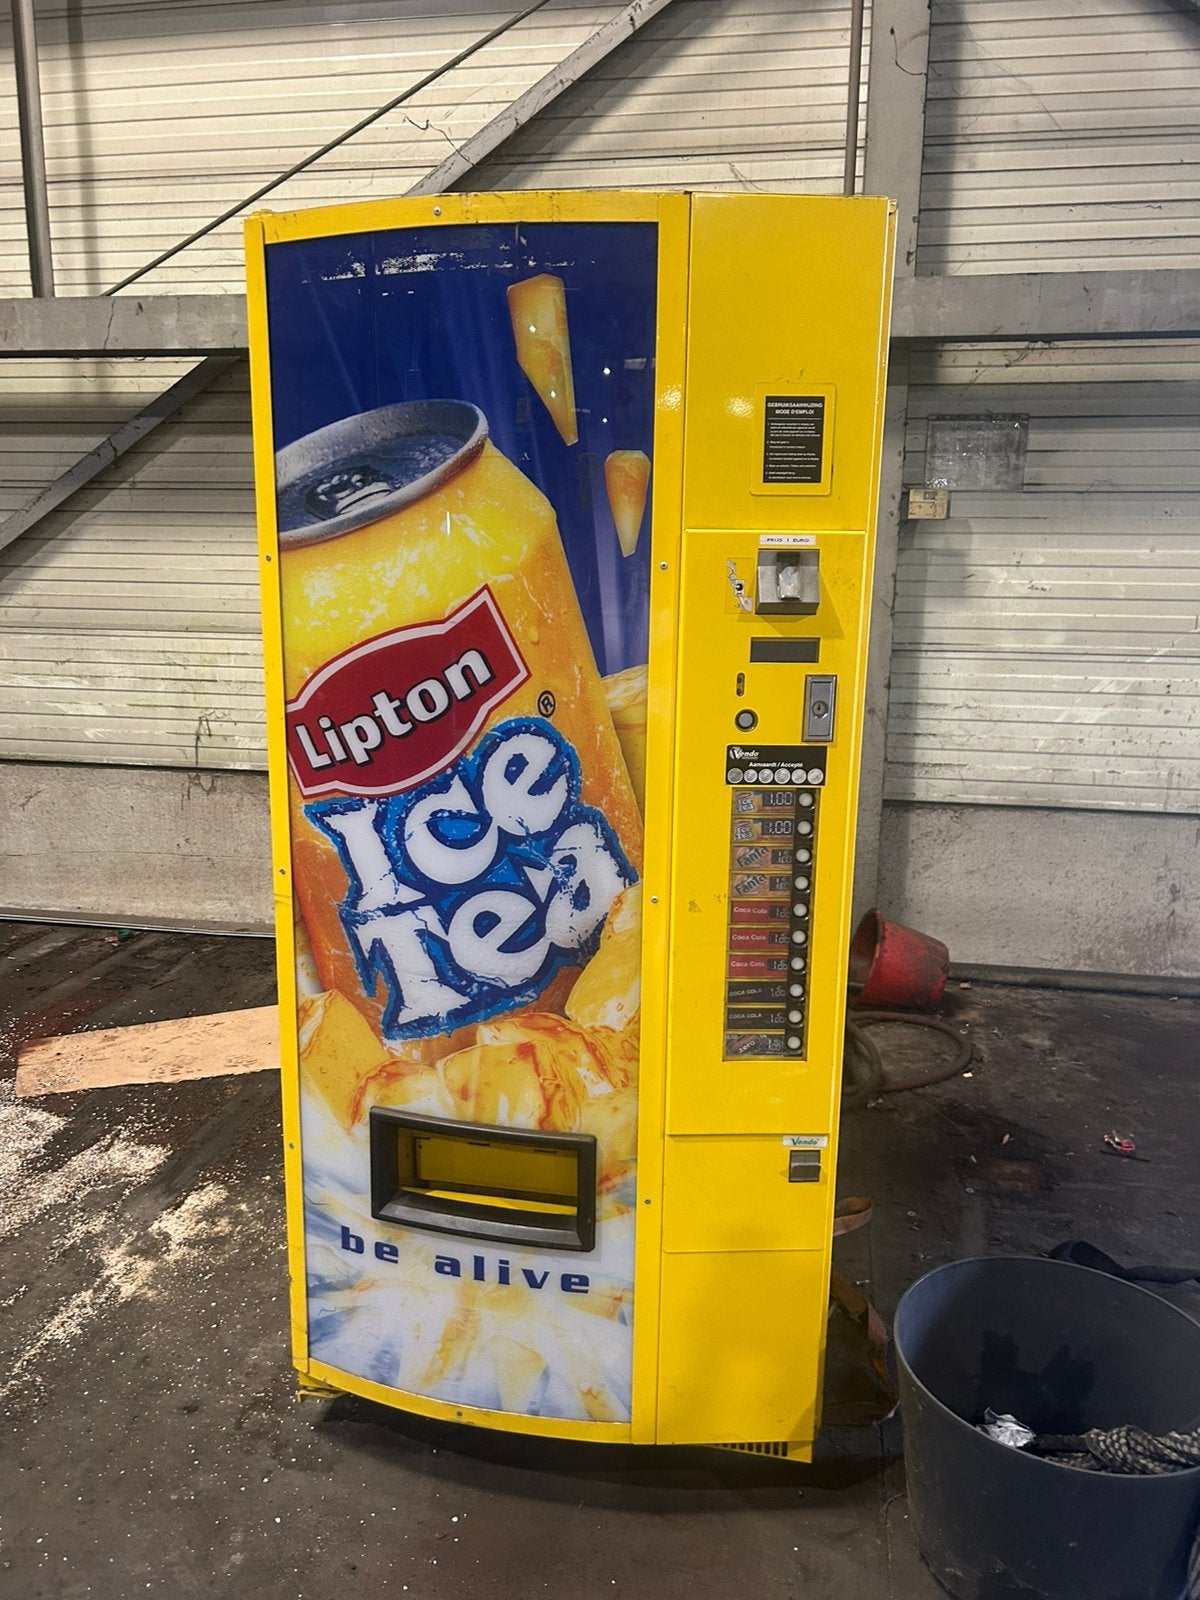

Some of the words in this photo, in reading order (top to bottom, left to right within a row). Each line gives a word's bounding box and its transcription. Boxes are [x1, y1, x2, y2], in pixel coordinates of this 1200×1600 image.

[294, 647, 495, 770] Lipton
[733, 747, 760, 758] Vendo
[323, 732, 569, 912] Ice
[736, 846, 769, 868] Fanta
[735, 874, 767, 895] Fanta
[353, 821, 633, 1026] Tea
[791, 1137, 818, 1146] Vendo
[340, 1224, 399, 1264] be
[434, 1254, 590, 1294] alive
